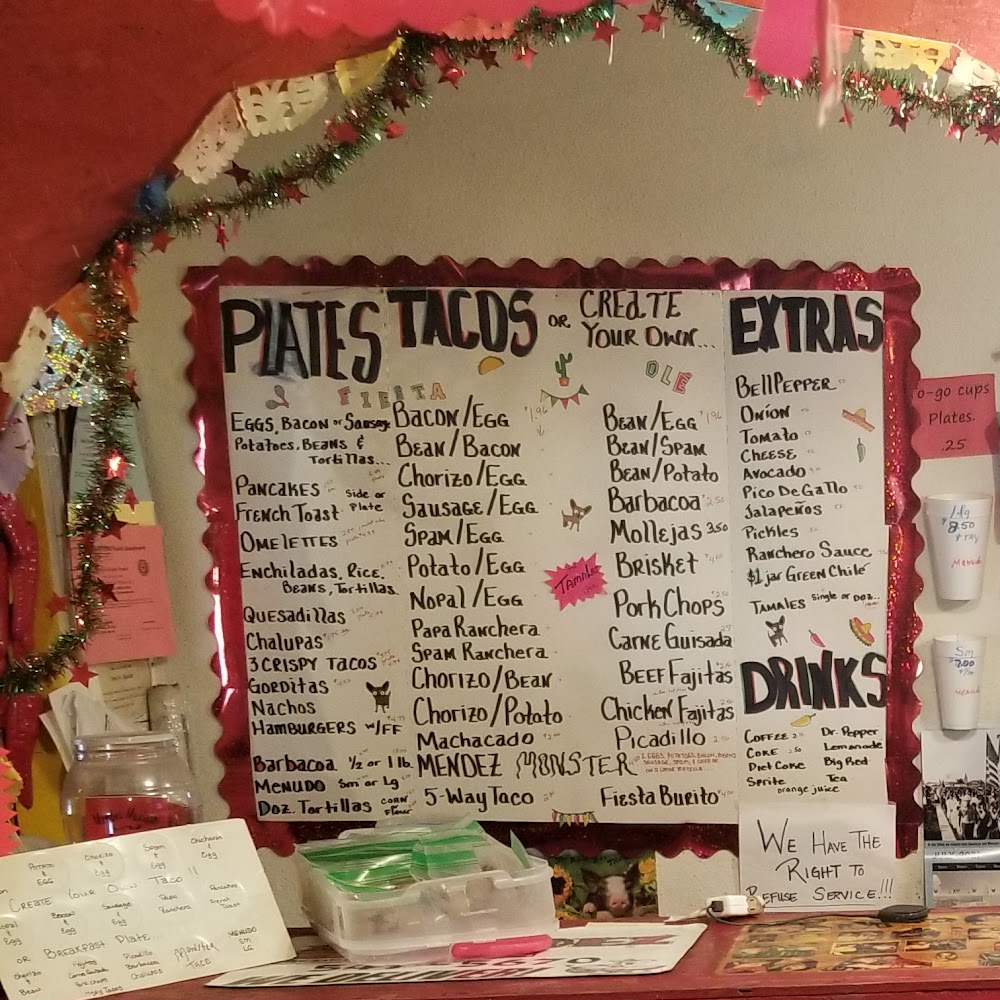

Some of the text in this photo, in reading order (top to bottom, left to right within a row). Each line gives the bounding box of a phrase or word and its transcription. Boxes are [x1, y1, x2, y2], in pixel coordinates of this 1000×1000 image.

[386, 289, 538, 358] TACOS
[581, 321, 639, 349] YOUR
[729, 294, 883, 355] EXTRAS
[957, 383, 990, 400] cups
[819, 541, 872, 558] Sauce
[613, 586, 661, 619] Pork
[664, 622, 733, 649] Guisada
[249, 658, 258, 671] 3
[668, 657, 733, 691] Fajitas
[739, 650, 887, 715] DRINKS
[678, 694, 735, 726] Fajitas
[614, 724, 706, 751] Picadillo
[418, 753, 503, 778] MENDEZ
[812, 830, 847, 855] HAVE
[849, 830, 881, 849] THE
[775, 858, 842, 883] RIGHT
